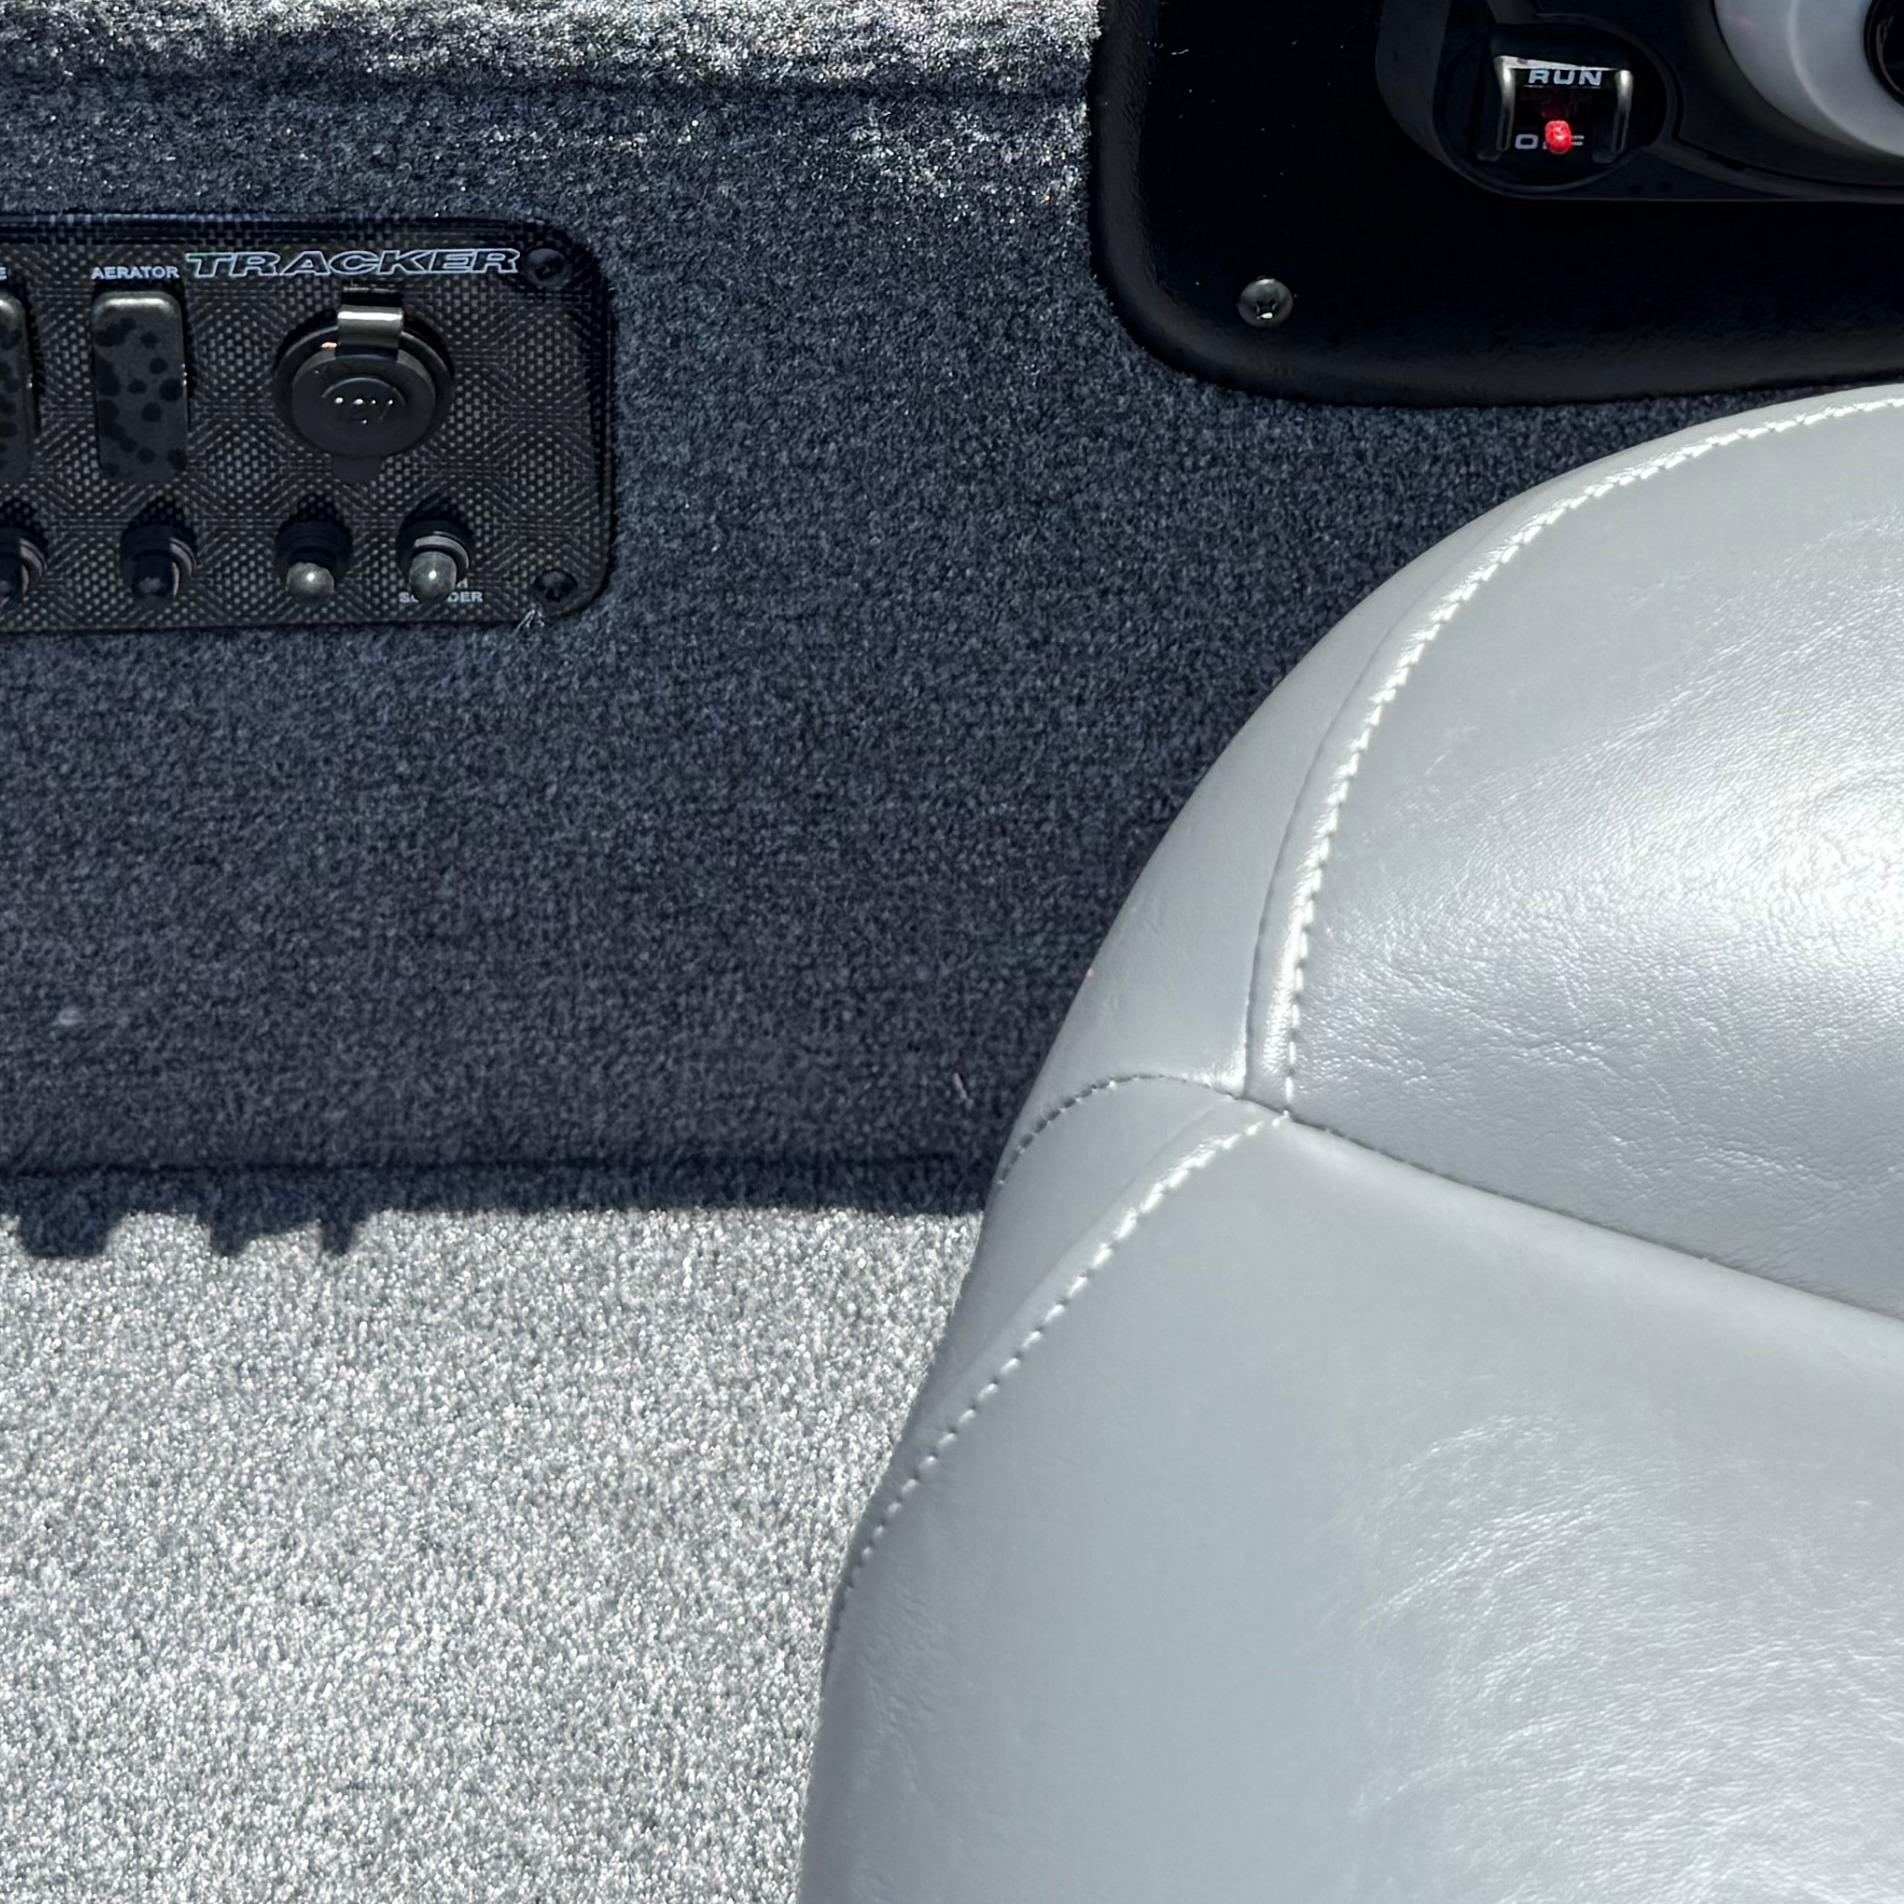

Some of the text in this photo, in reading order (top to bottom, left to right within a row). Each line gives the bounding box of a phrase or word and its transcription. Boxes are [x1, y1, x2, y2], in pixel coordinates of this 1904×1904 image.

[1528, 69, 1602, 86] RUN
[91, 264, 181, 280] AERATOR
[185, 248, 521, 280] TRACKER
